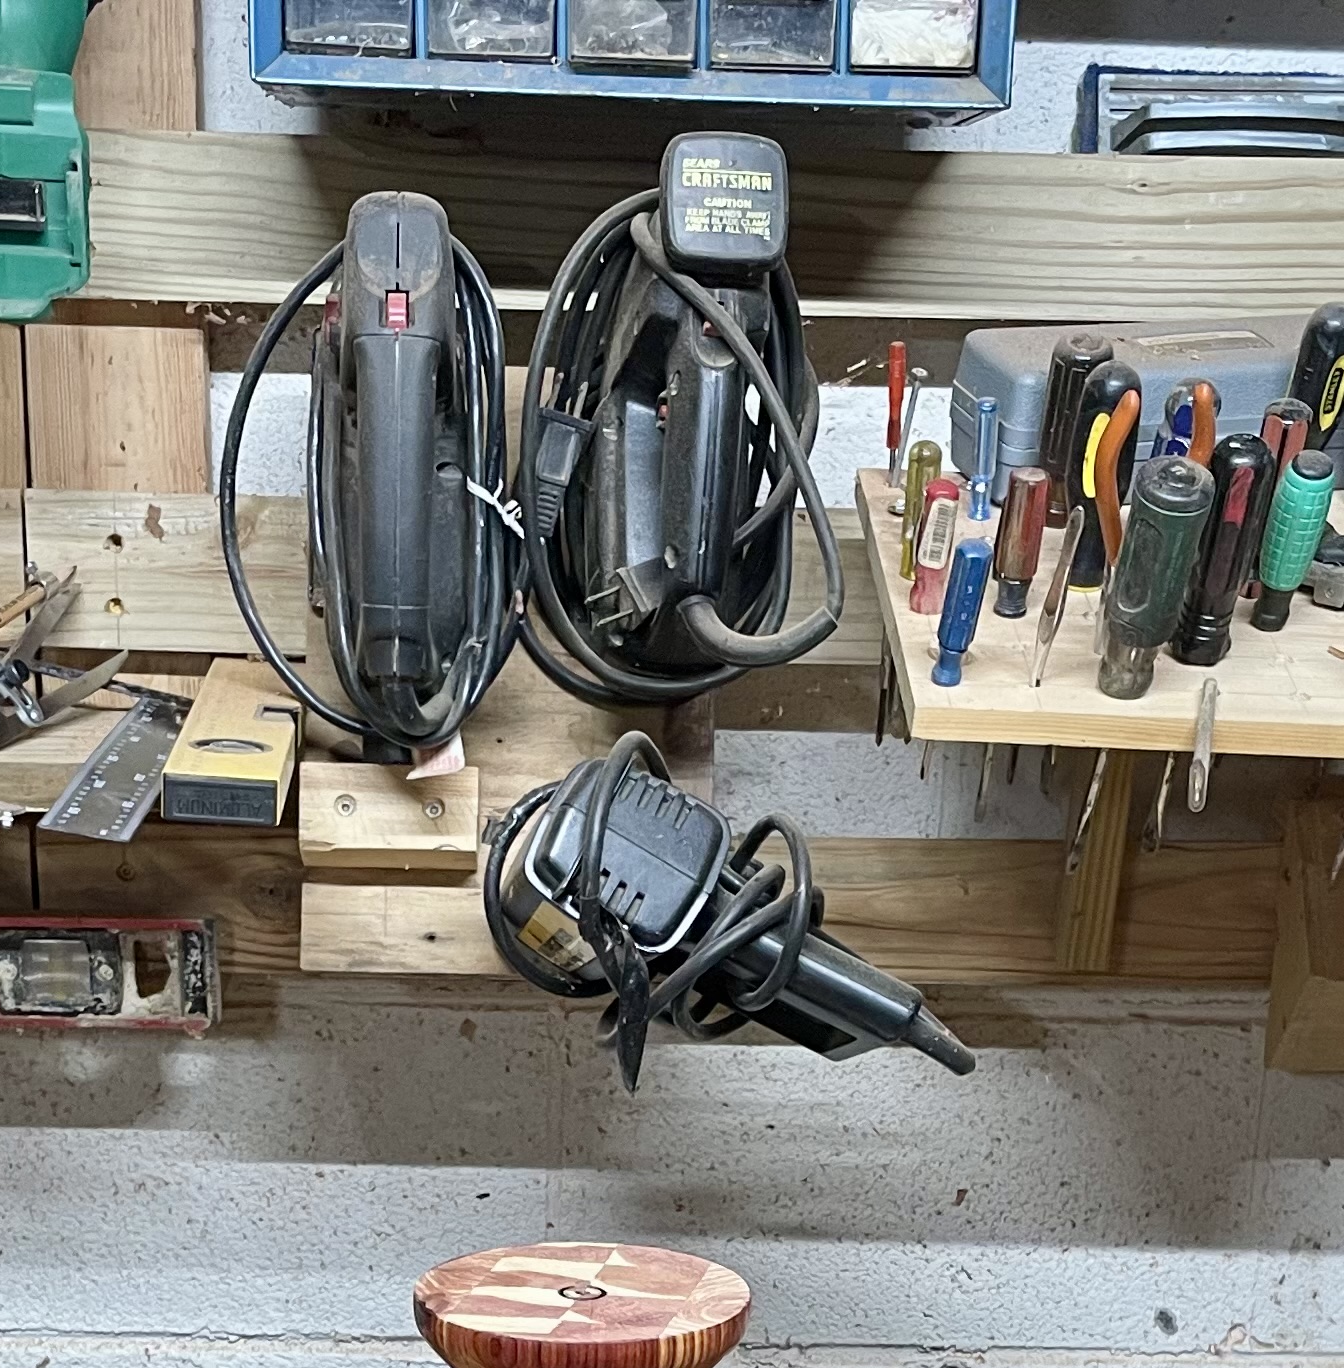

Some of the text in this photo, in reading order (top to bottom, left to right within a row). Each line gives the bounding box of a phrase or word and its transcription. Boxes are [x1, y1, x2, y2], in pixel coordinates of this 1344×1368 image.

[682, 158, 721, 169] SEARS
[681, 172, 773, 191] CRAFTSMAN
[703, 197, 753, 209] CAUTION
[686, 208, 711, 216] KEEP
[712, 209, 743, 218] HANDS
[684, 216, 771, 228] FROM BLADE CLAMP
[685, 224, 771, 236] AREA AT ALL TIMES
[1324, 370, 1341, 412] STANLEY
